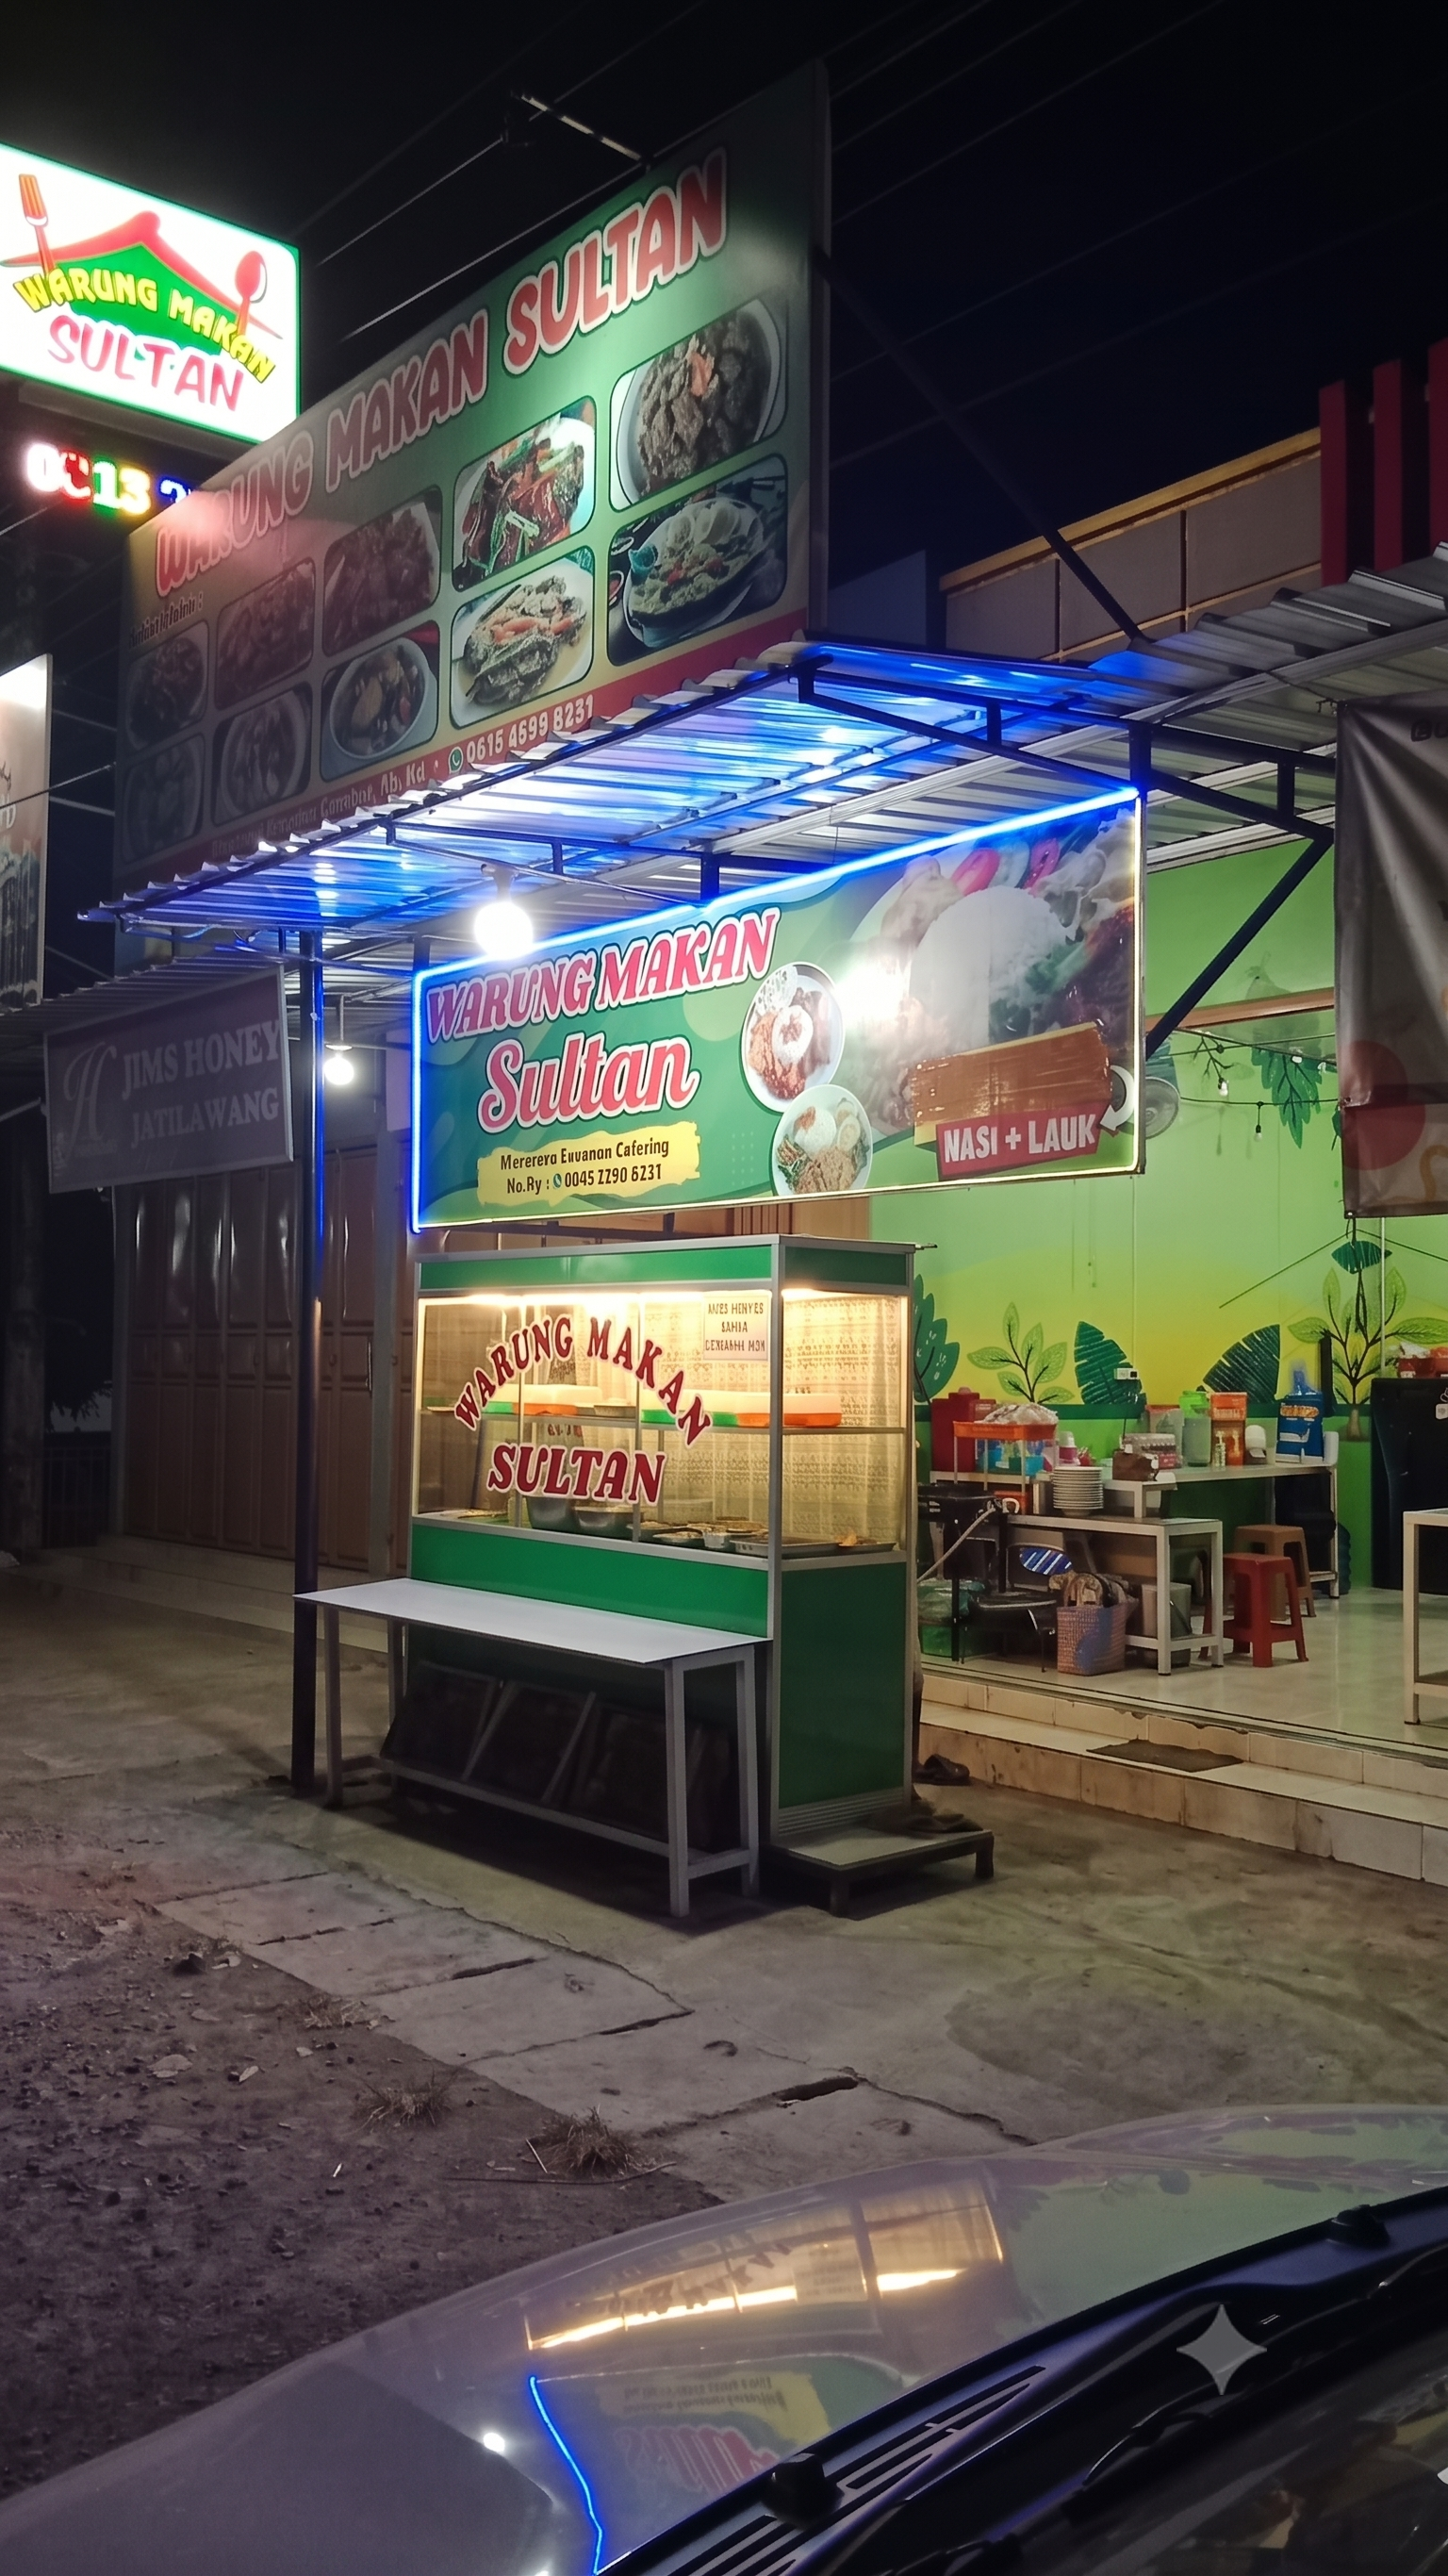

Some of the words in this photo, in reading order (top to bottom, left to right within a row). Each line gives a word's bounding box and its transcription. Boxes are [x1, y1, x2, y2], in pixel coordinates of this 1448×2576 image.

[13, 267, 157, 313] WARUNG
[168, 288, 276, 384] MAKAN
[48, 314, 244, 411] SULTAN
[325, 307, 488, 494] MAKAN
[503, 146, 727, 375] SULTAN
[467, 730, 504, 764] 0615
[508, 712, 549, 749] 4699
[552, 694, 594, 732] 8231
[426, 949, 598, 1044] WARUNG
[595, 907, 781, 1010] MAKAN
[122, 1043, 179, 1100] JIMS
[183, 1019, 281, 1078] HONEY
[478, 1032, 700, 1132] Sultan
[131, 1087, 280, 1149] JATILAWANG
[944, 1126, 997, 1163] NASI
[1028, 1114, 1096, 1154] LAUK
[453, 1315, 573, 1430] WARUNG
[586, 1316, 713, 1446] MAKAN
[487, 1443, 666, 1505] SULTAN
